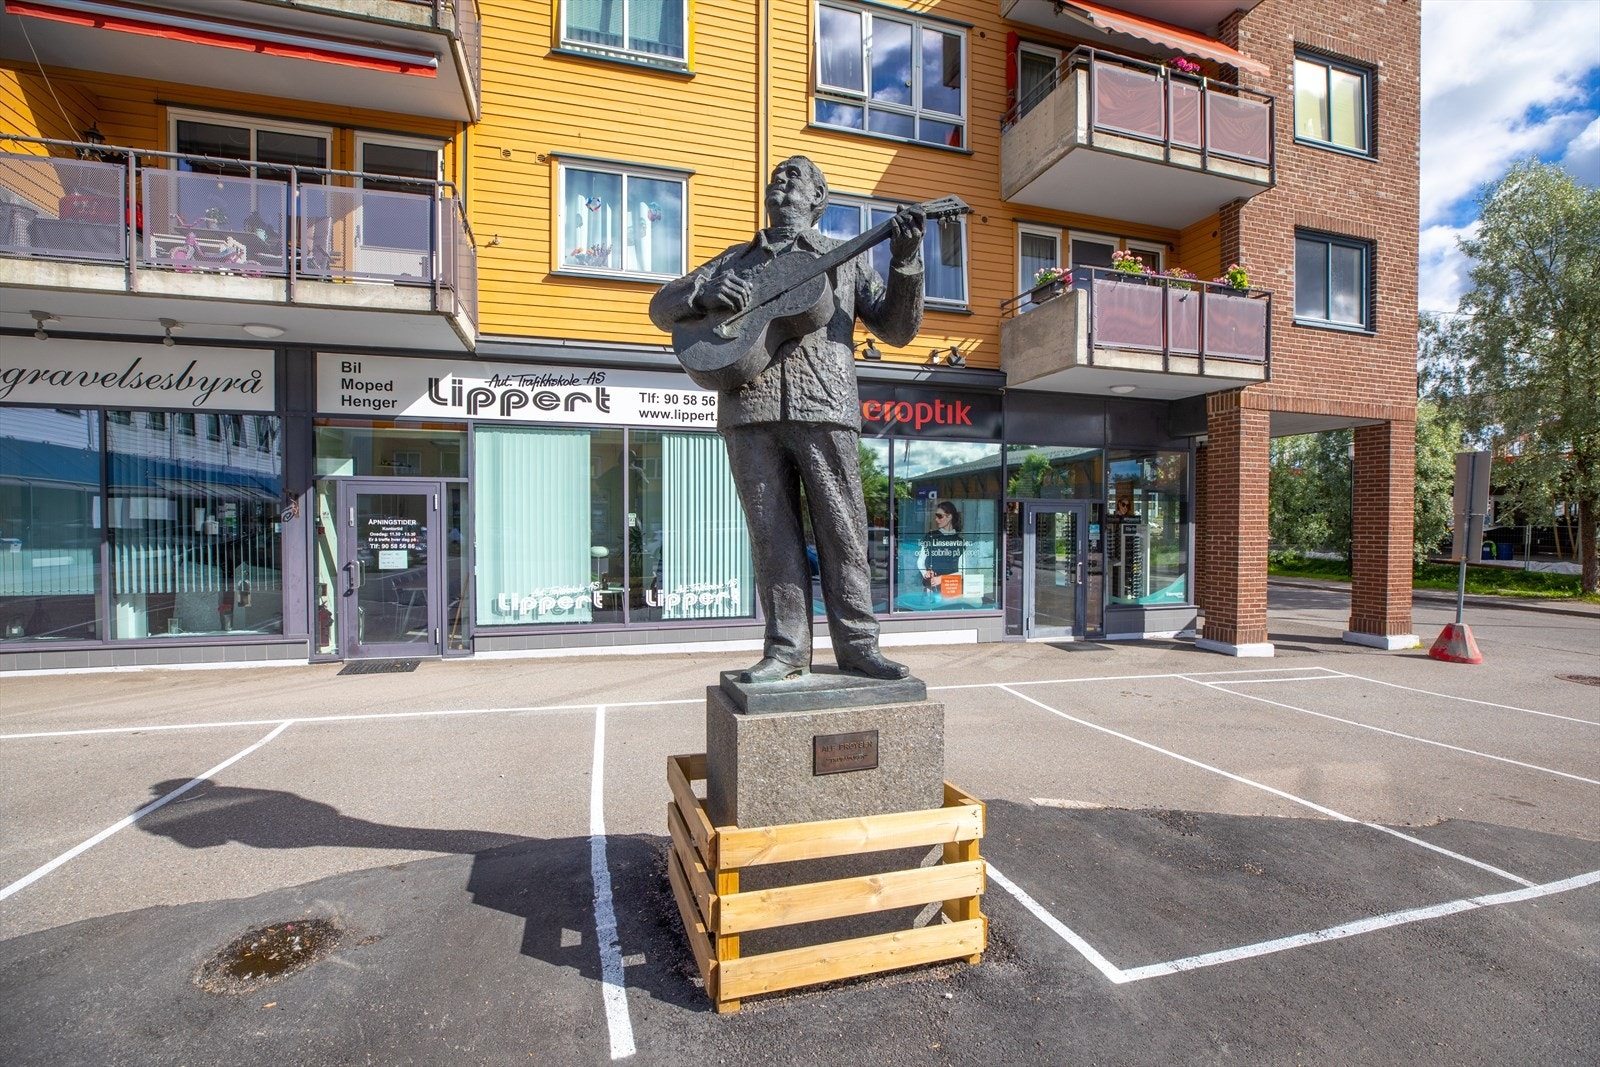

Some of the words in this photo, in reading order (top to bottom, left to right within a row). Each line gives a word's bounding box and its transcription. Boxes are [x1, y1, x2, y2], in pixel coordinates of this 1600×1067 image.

[341, 361, 362, 374] Bil
[0, 357, 264, 407] gravelsesbyrå
[341, 378, 393, 393] Moped
[511, 373, 582, 392] Trafikkskole
[582, 371, 606, 385] AS
[341, 394, 398, 411] Henger
[428, 377, 611, 417] Lippert
[639, 392, 660, 404] Tlf:
[664, 393, 679, 405] 90
[683, 394, 697, 406] 58
[701, 395, 716, 407] 56
[859, 399, 973, 430] eroptik
[498, 591, 603, 615] Lippert
